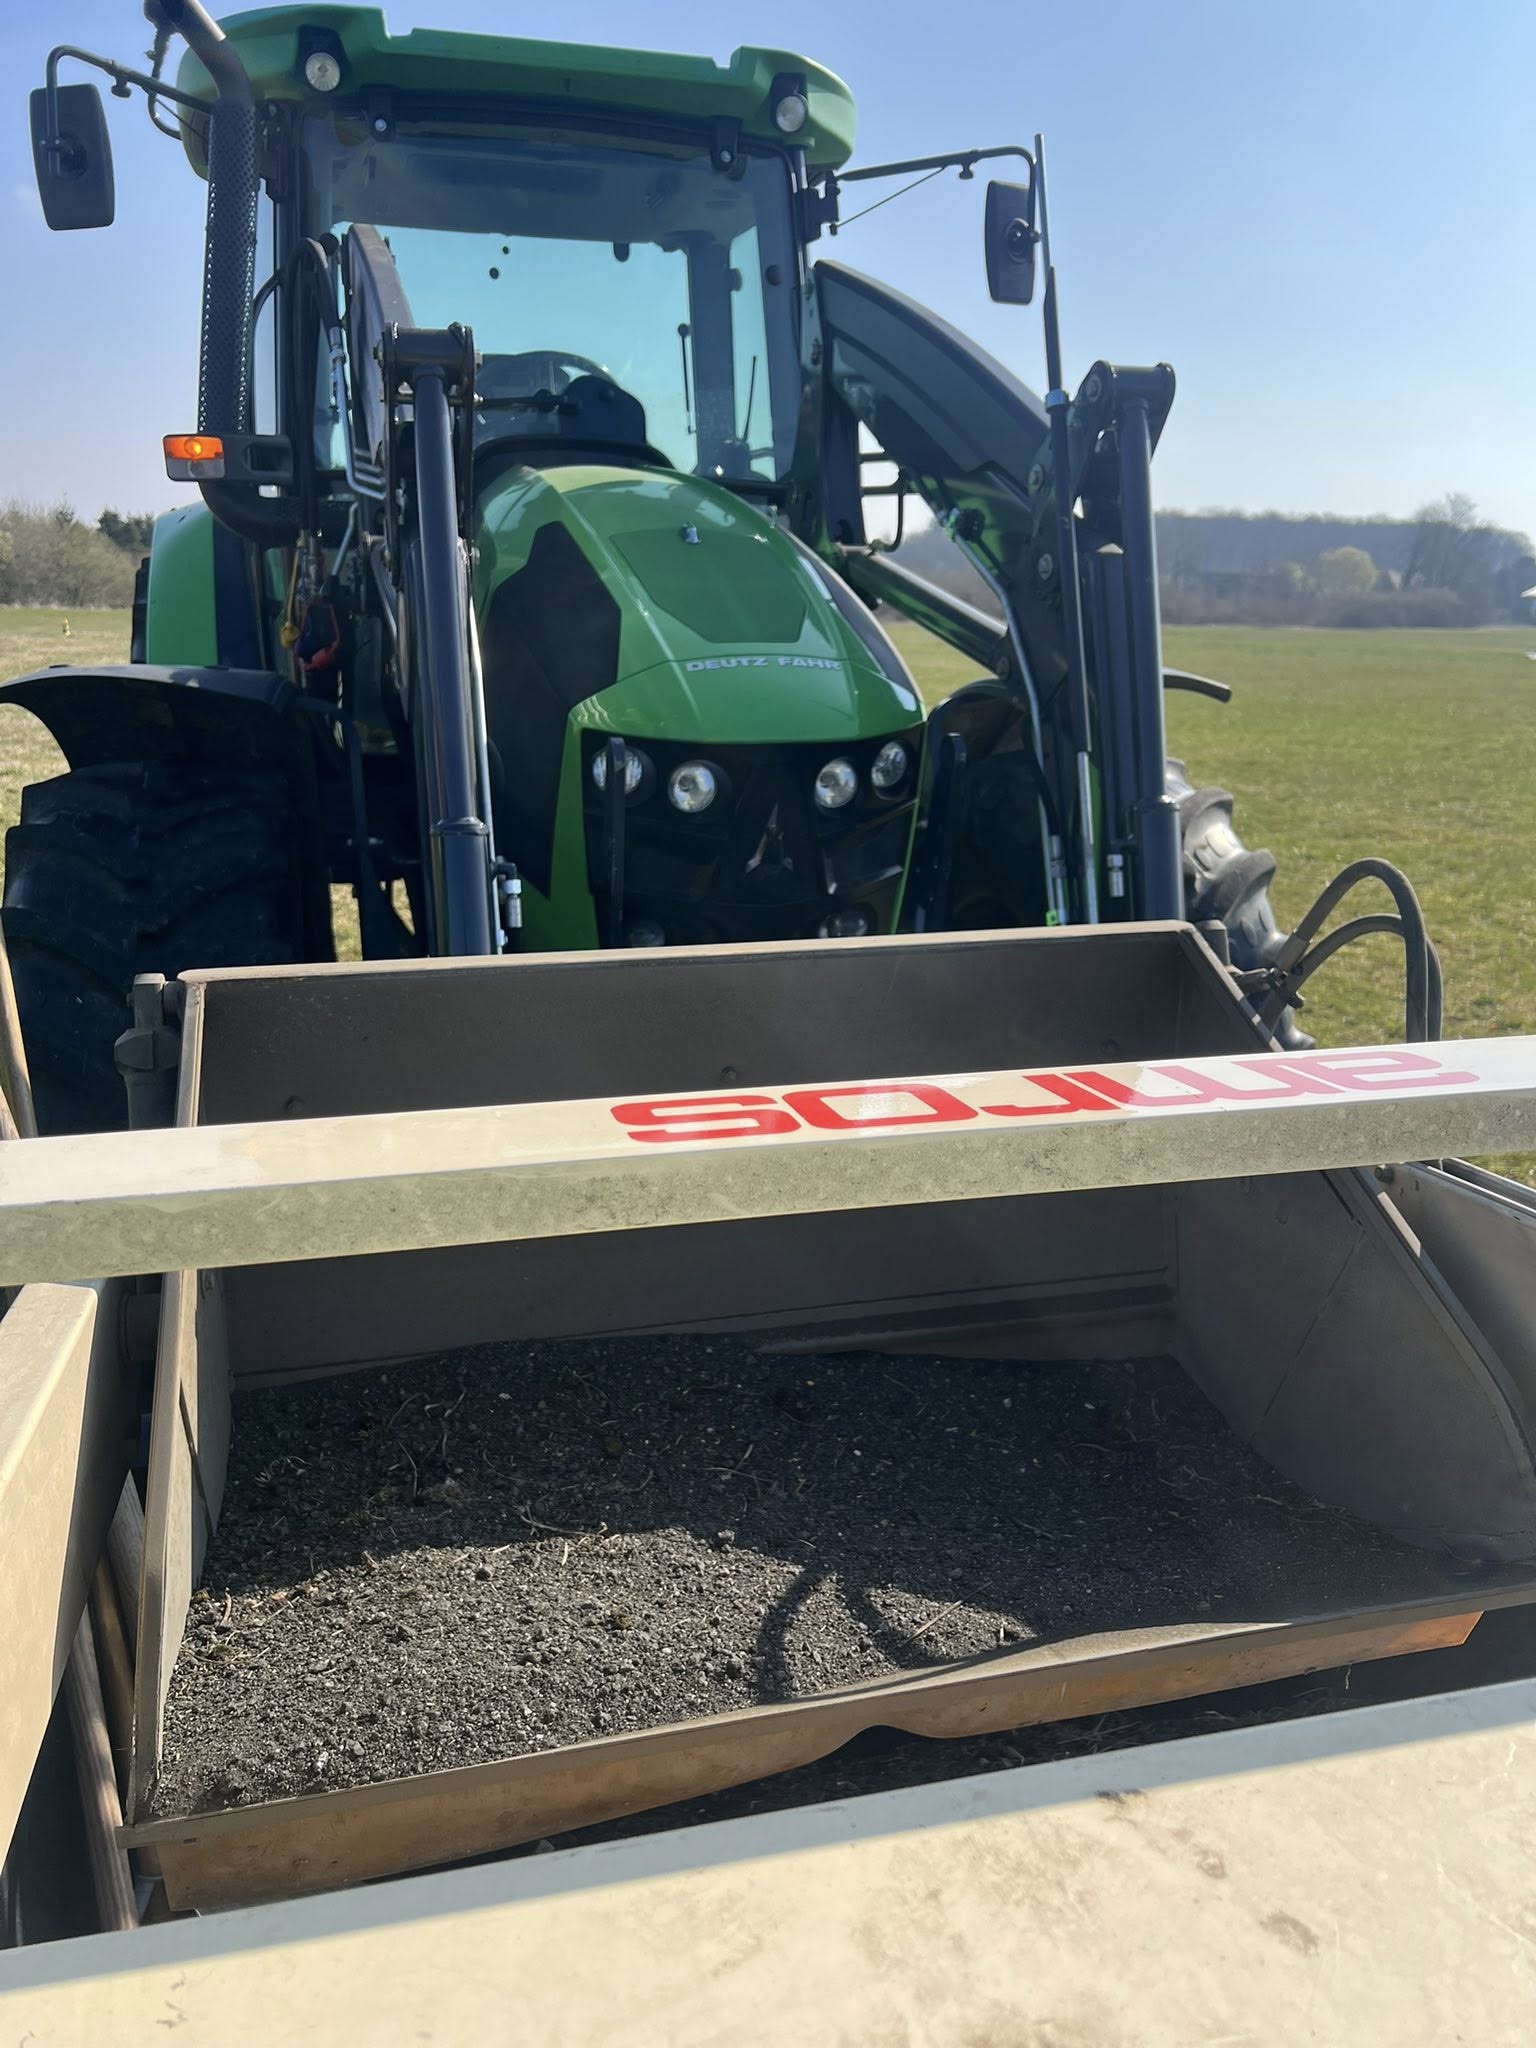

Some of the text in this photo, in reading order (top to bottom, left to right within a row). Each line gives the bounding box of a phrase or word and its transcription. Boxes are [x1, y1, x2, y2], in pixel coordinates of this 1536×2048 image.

[686, 656, 841, 671] DEUTZ FAHR
[610, 1051, 1480, 1143] amros
